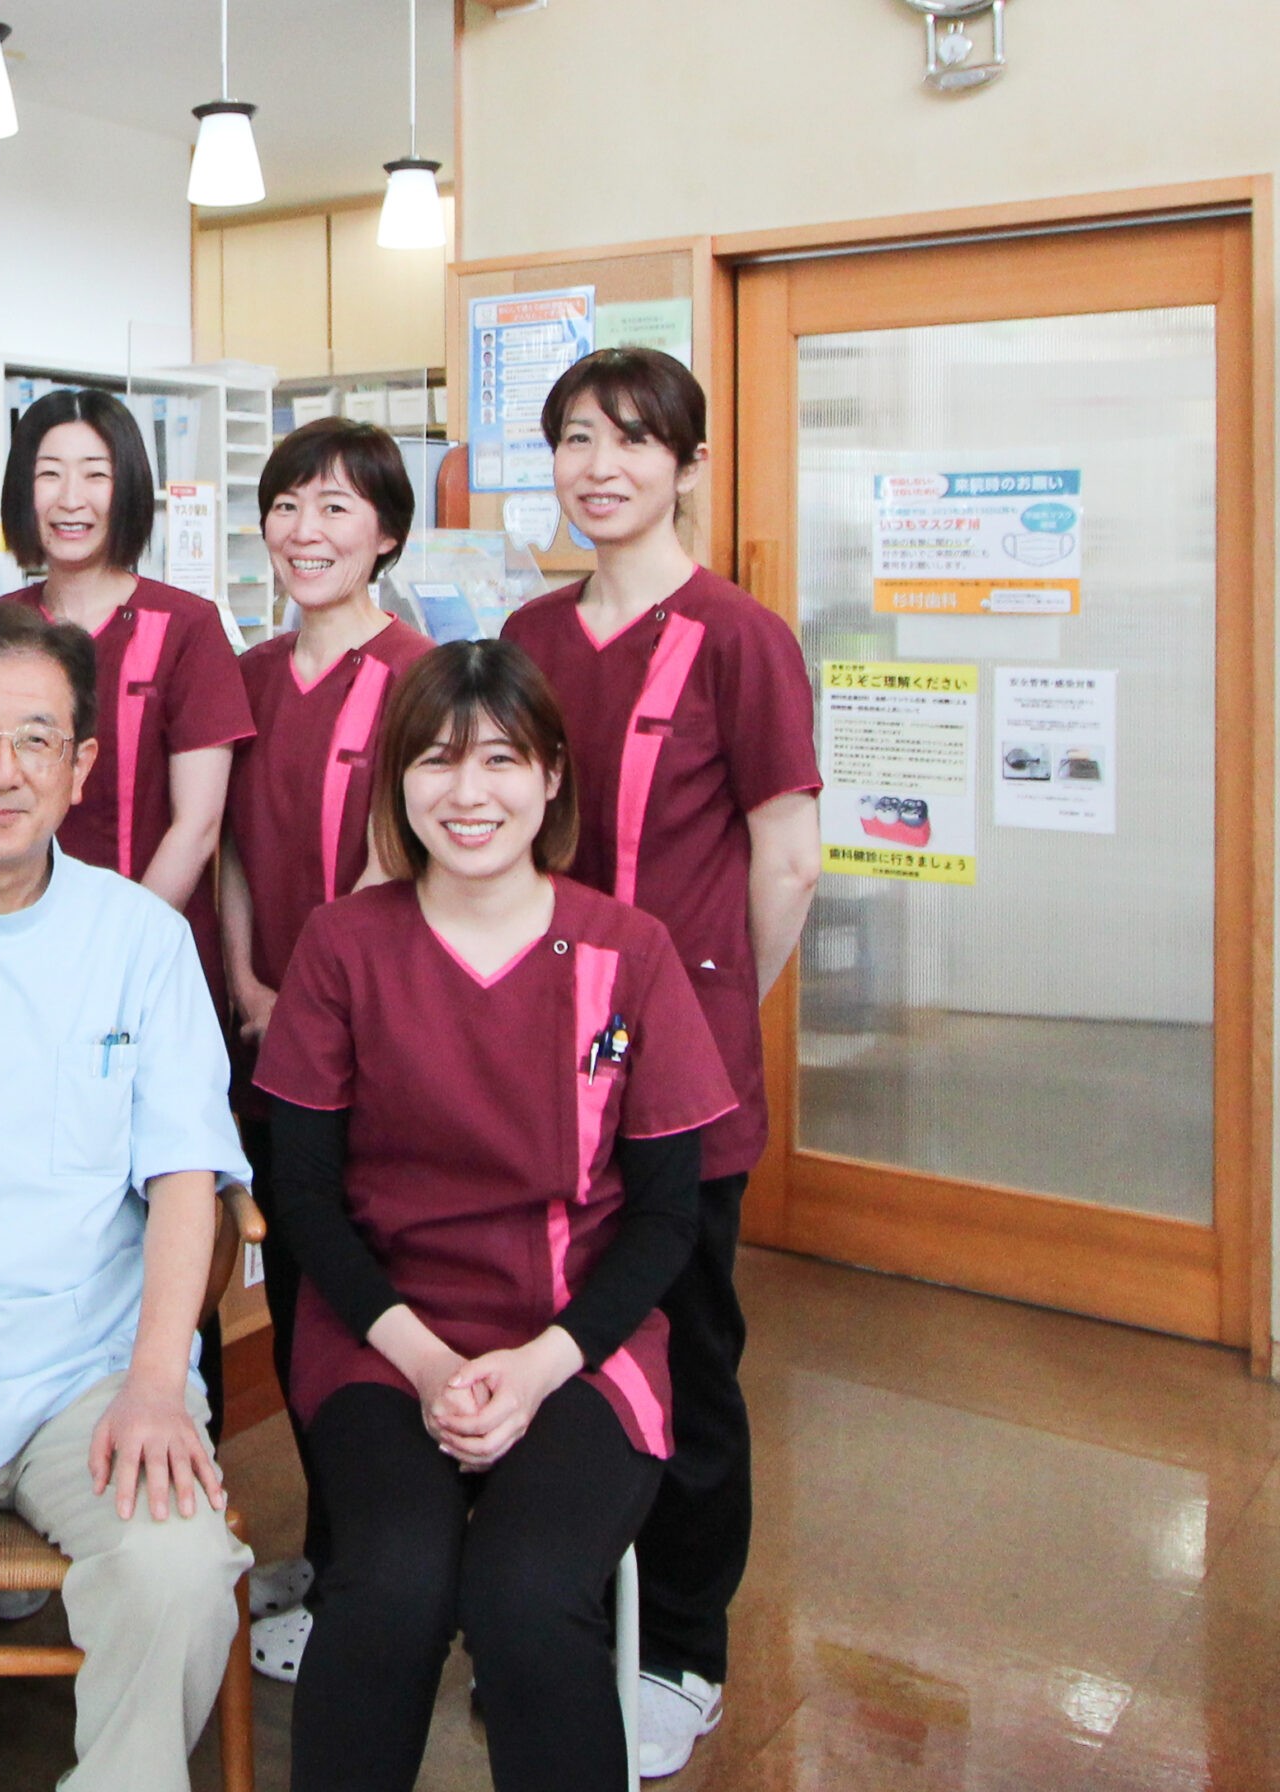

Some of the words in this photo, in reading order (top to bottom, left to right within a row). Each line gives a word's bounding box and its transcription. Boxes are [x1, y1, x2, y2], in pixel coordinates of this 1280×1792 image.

[830, 673, 968, 691] どうぞご理解ください
[828, 847, 967, 872] 歯科健診に行きましょう
